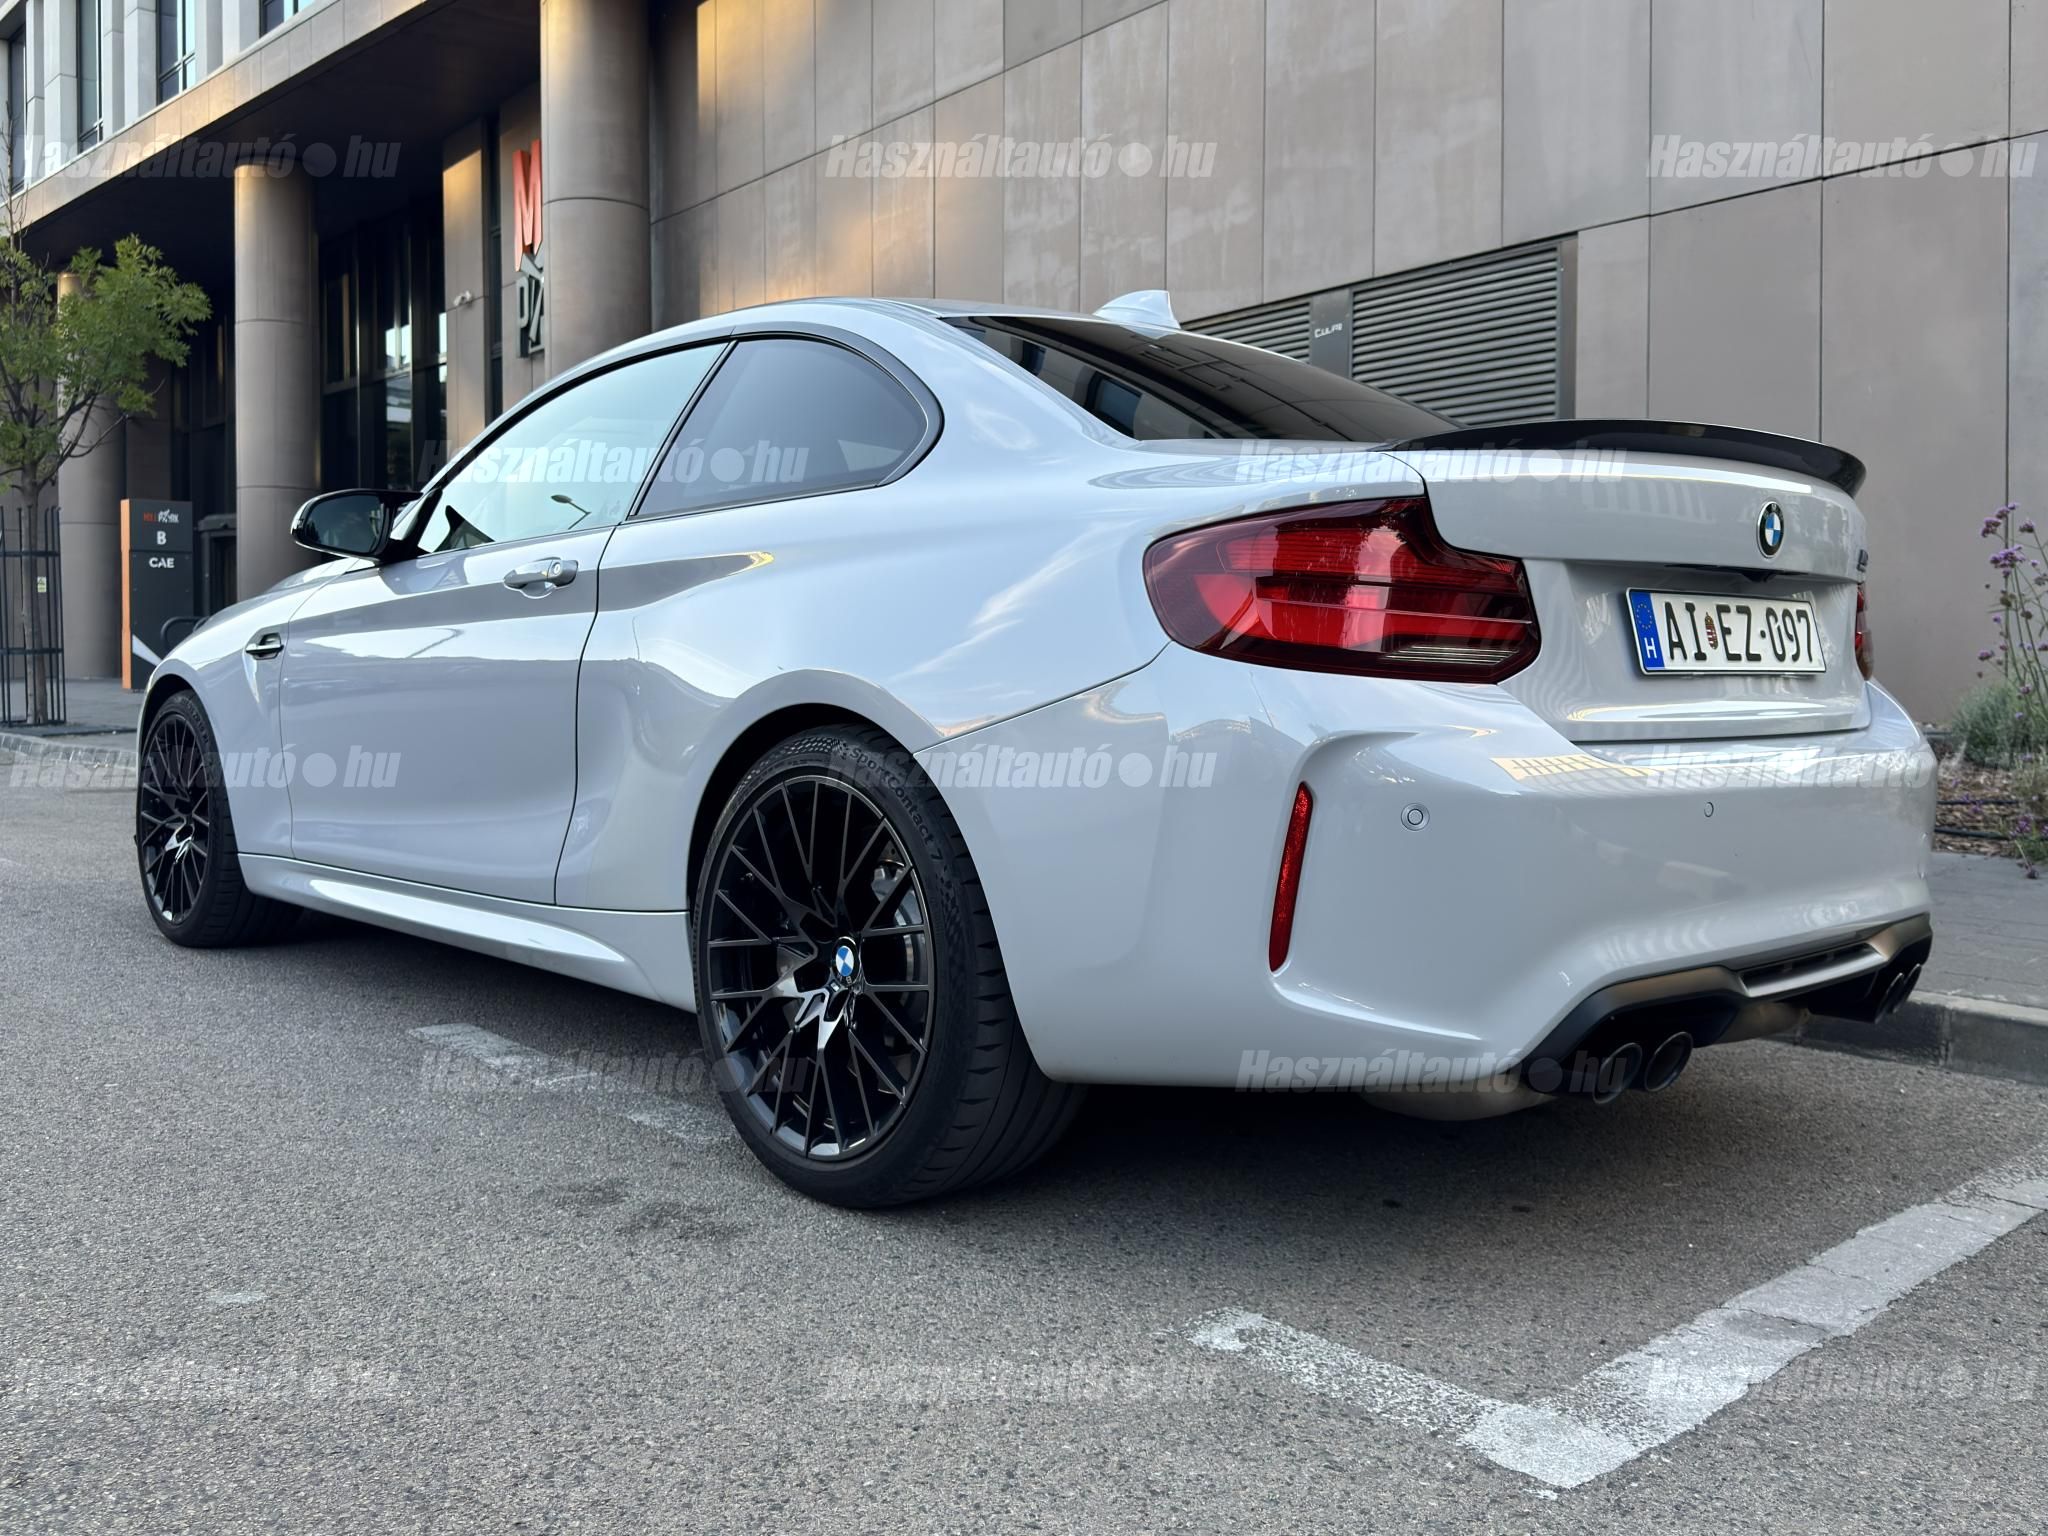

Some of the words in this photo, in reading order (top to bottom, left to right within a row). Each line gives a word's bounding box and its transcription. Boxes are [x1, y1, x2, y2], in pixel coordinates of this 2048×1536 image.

[156, 530, 167, 545] B
[148, 556, 175, 569] CAE
[1643, 637, 1658, 660] H
[849, 746, 935, 847] SportContact
